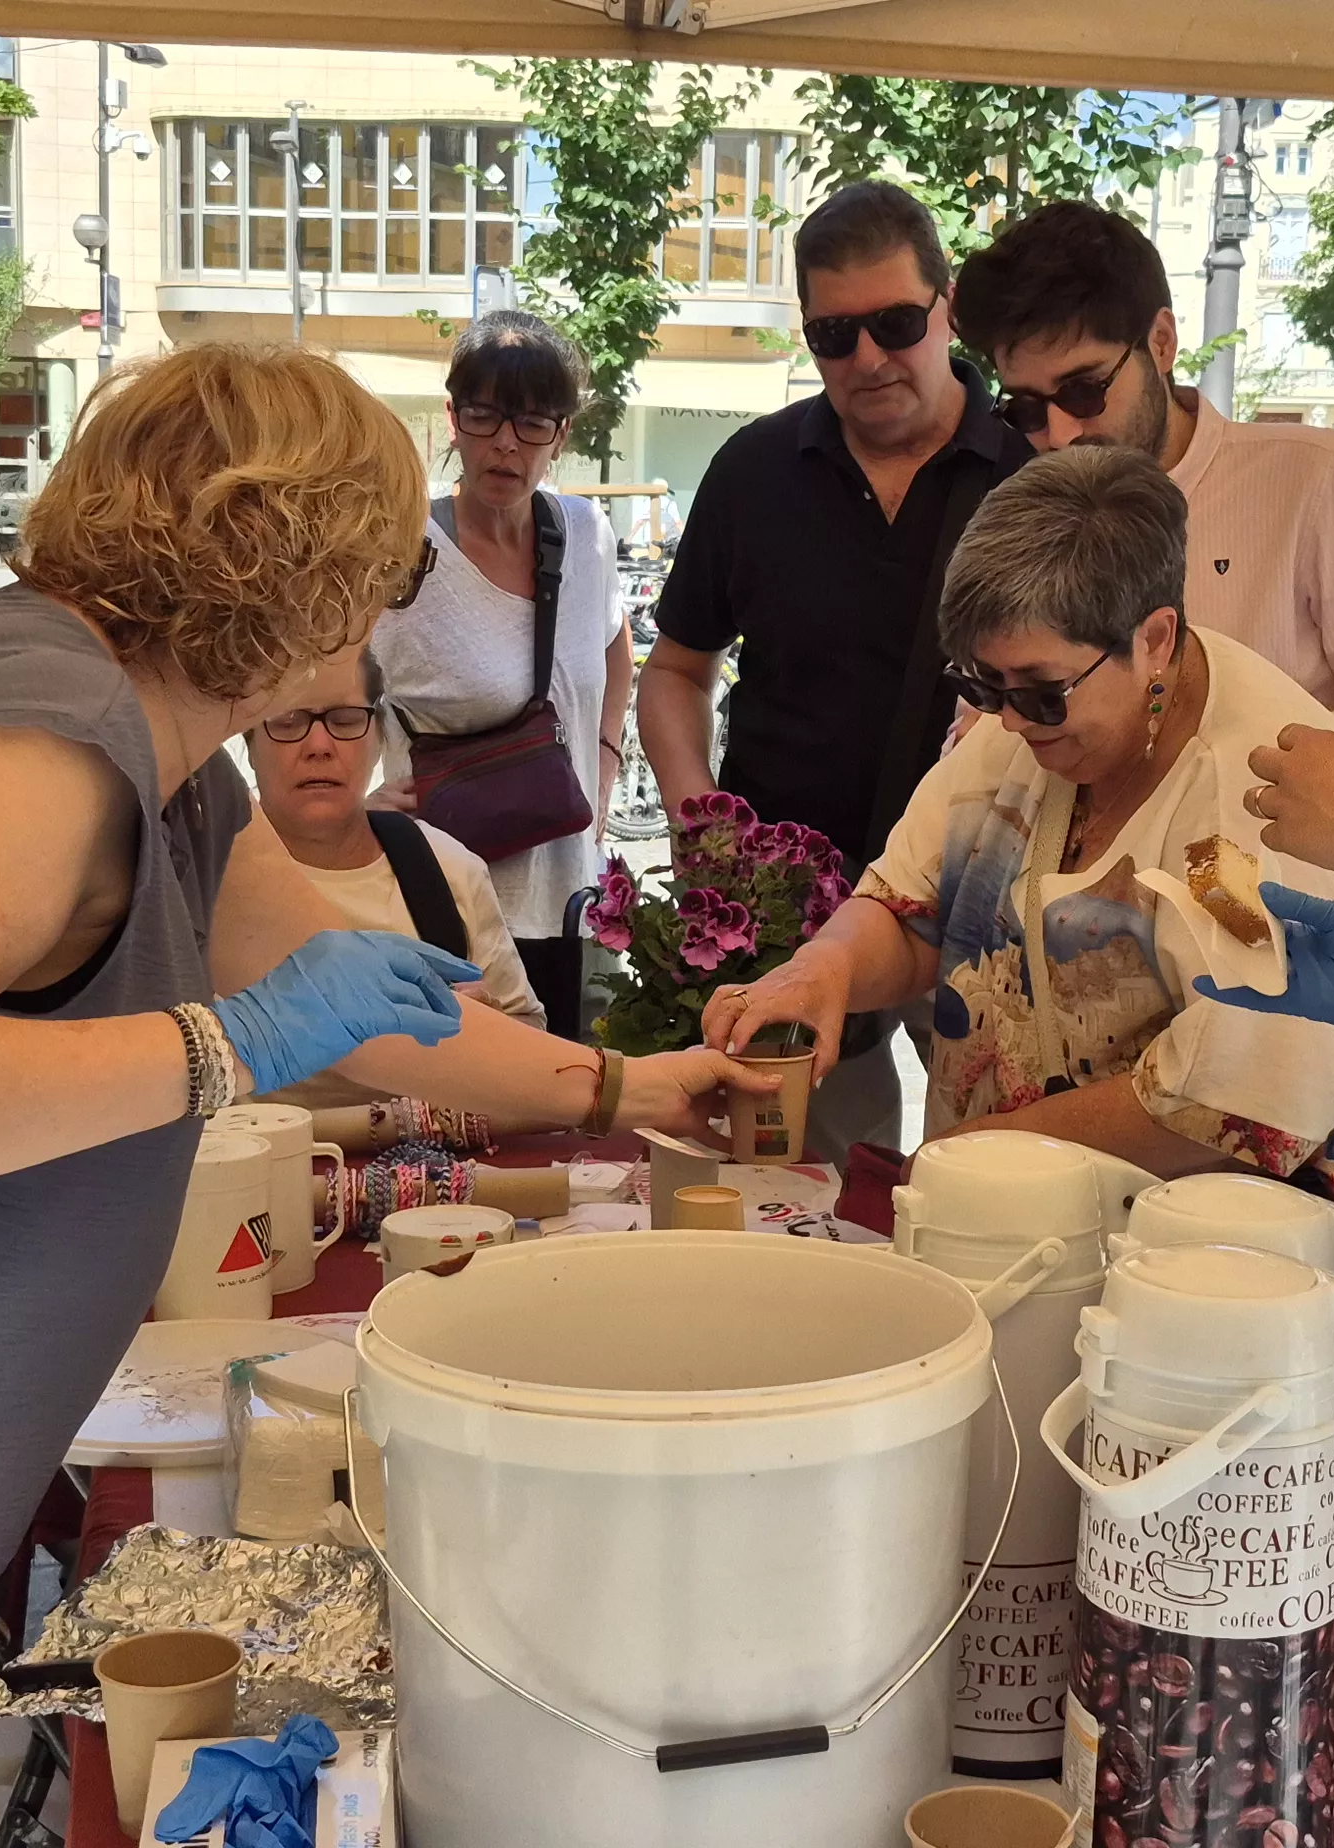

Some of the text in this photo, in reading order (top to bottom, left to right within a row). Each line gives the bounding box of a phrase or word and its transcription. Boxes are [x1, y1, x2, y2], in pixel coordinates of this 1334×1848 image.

[1264, 1452, 1325, 1489] CAFÉ
[1197, 1491, 1292, 1513] COFFEE
[1241, 1514, 1315, 1554] CAFÉ
[1088, 1547, 1145, 1594] CAFÉ
[1145, 1550, 1289, 1588] CFEE
[1298, 1566, 1322, 1582] café
[1012, 1575, 1073, 1604] CAFÉ
[967, 1604, 1037, 1624] OFFEE
[1104, 1589, 1189, 1630] COFFEE
[1219, 1611, 1274, 1628] coffee
[990, 1626, 1064, 1658] CAFÉ
[1047, 1671, 1067, 1684] caf
[975, 1708, 1023, 1722] coffee
